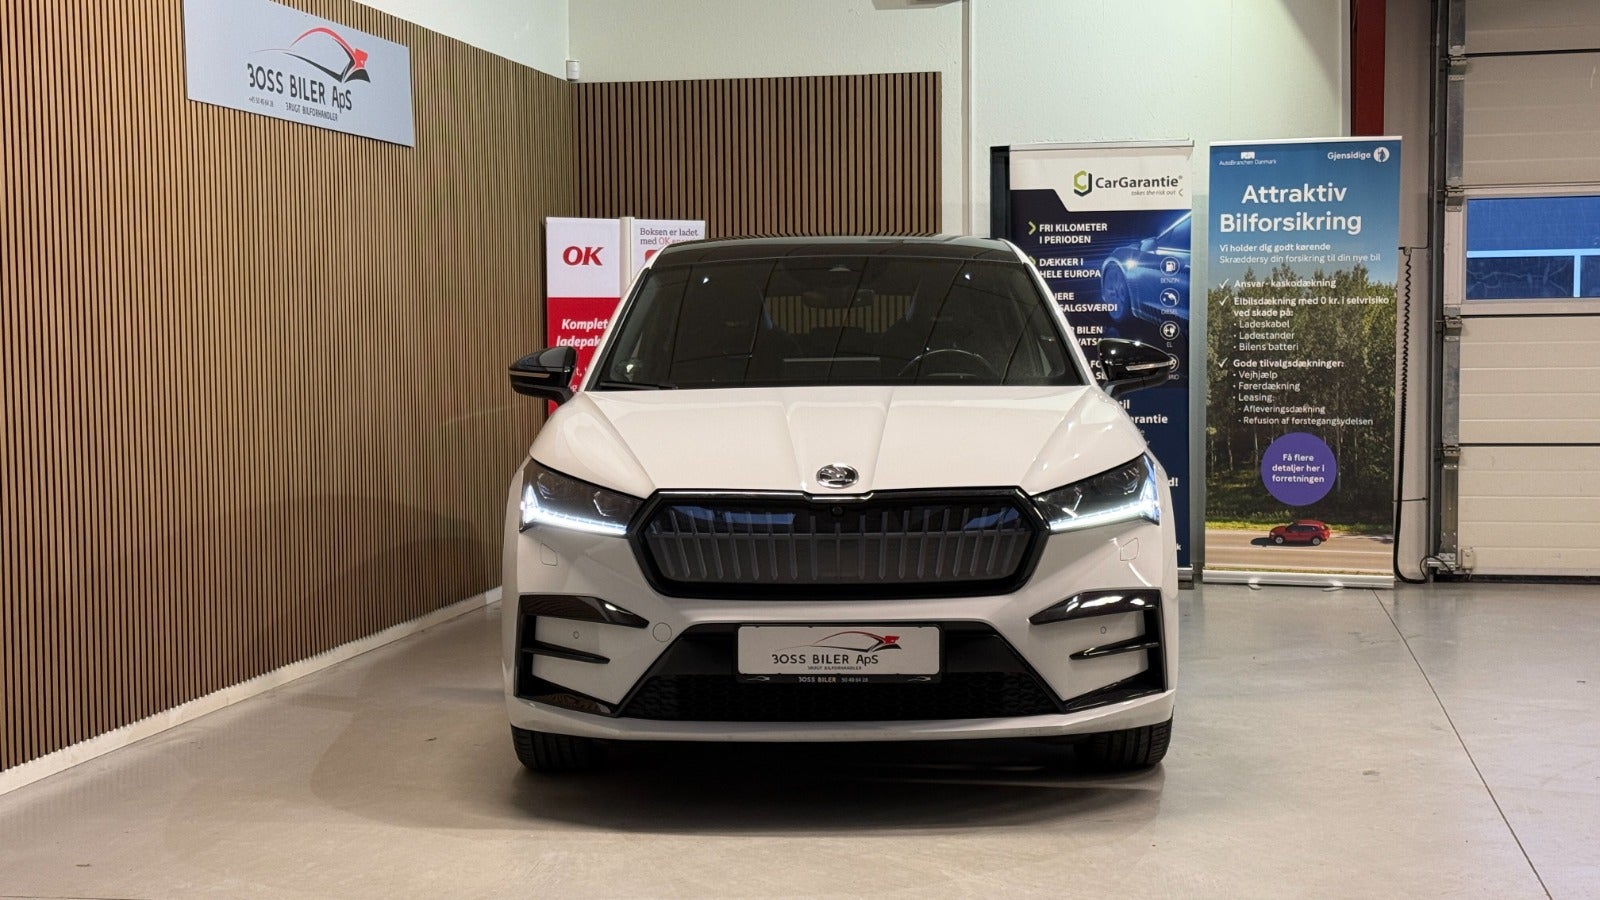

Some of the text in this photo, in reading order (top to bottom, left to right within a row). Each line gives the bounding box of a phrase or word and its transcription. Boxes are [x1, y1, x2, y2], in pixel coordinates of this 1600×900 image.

[289, 74, 326, 105] BILER
[332, 85, 352, 113] ApS
[302, 106, 338, 121] BILFORHANDLER
[1327, 151, 1371, 160] Gjensidige
[1241, 182, 1347, 204] Attraktiv
[1039, 222, 1108, 233] FRI KILOMETER
[1220, 211, 1362, 235] Bilforsikring
[639, 228, 668, 236] Boksen
[679, 228, 699, 237] ladet
[640, 237, 657, 245] med
[658, 236, 670, 245] OK
[1039, 235, 1091, 244] I PERIODEN
[1219, 243, 1331, 253] Vi holder dig godt kørende
[562, 246, 605, 266] OK
[1219, 253, 1381, 265] Skræddersy din forsikring til din nye bil
[1039, 257, 1079, 267] DÆKKER
[1039, 269, 1101, 279] HELE EUROPA
[1271, 279, 1336, 289] kaskodækning
[1234, 296, 1297, 306] Elbilsdækning
[1298, 297, 1318, 305] med
[1320, 297, 1326, 305] 0
[1328, 297, 1340, 305] kr.
[1346, 296, 1389, 305] selvrisiko
[1059, 303, 1118, 313] SALGSVÆRDI
[1233, 308, 1294, 318] ved skade på:
[562, 318, 609, 332] Komplet
[1239, 320, 1290, 328] Ladeskabel
[1076, 326, 1103, 335] BILEN
[1239, 331, 1295, 340] Ladestander
[1238, 343, 1299, 351] Bilens batteri
[1233, 358, 1345, 370] Gode tilvalgsdækninger:
[1238, 371, 1278, 380] Vejhjælp
[1238, 382, 1300, 392] Førerdækning
[1243, 405, 1326, 415] Afleveringsdækning
[1243, 416, 1374, 427] Refusion af førstegangsydelsen
[1282, 453, 1314, 461] Få flere
[1271, 464, 1305, 474] detaljer
[1306, 464, 1320, 472] her
[1271, 474, 1325, 484] forretningen
[812, 654, 849, 664] BILER
[856, 654, 879, 667] ApS
